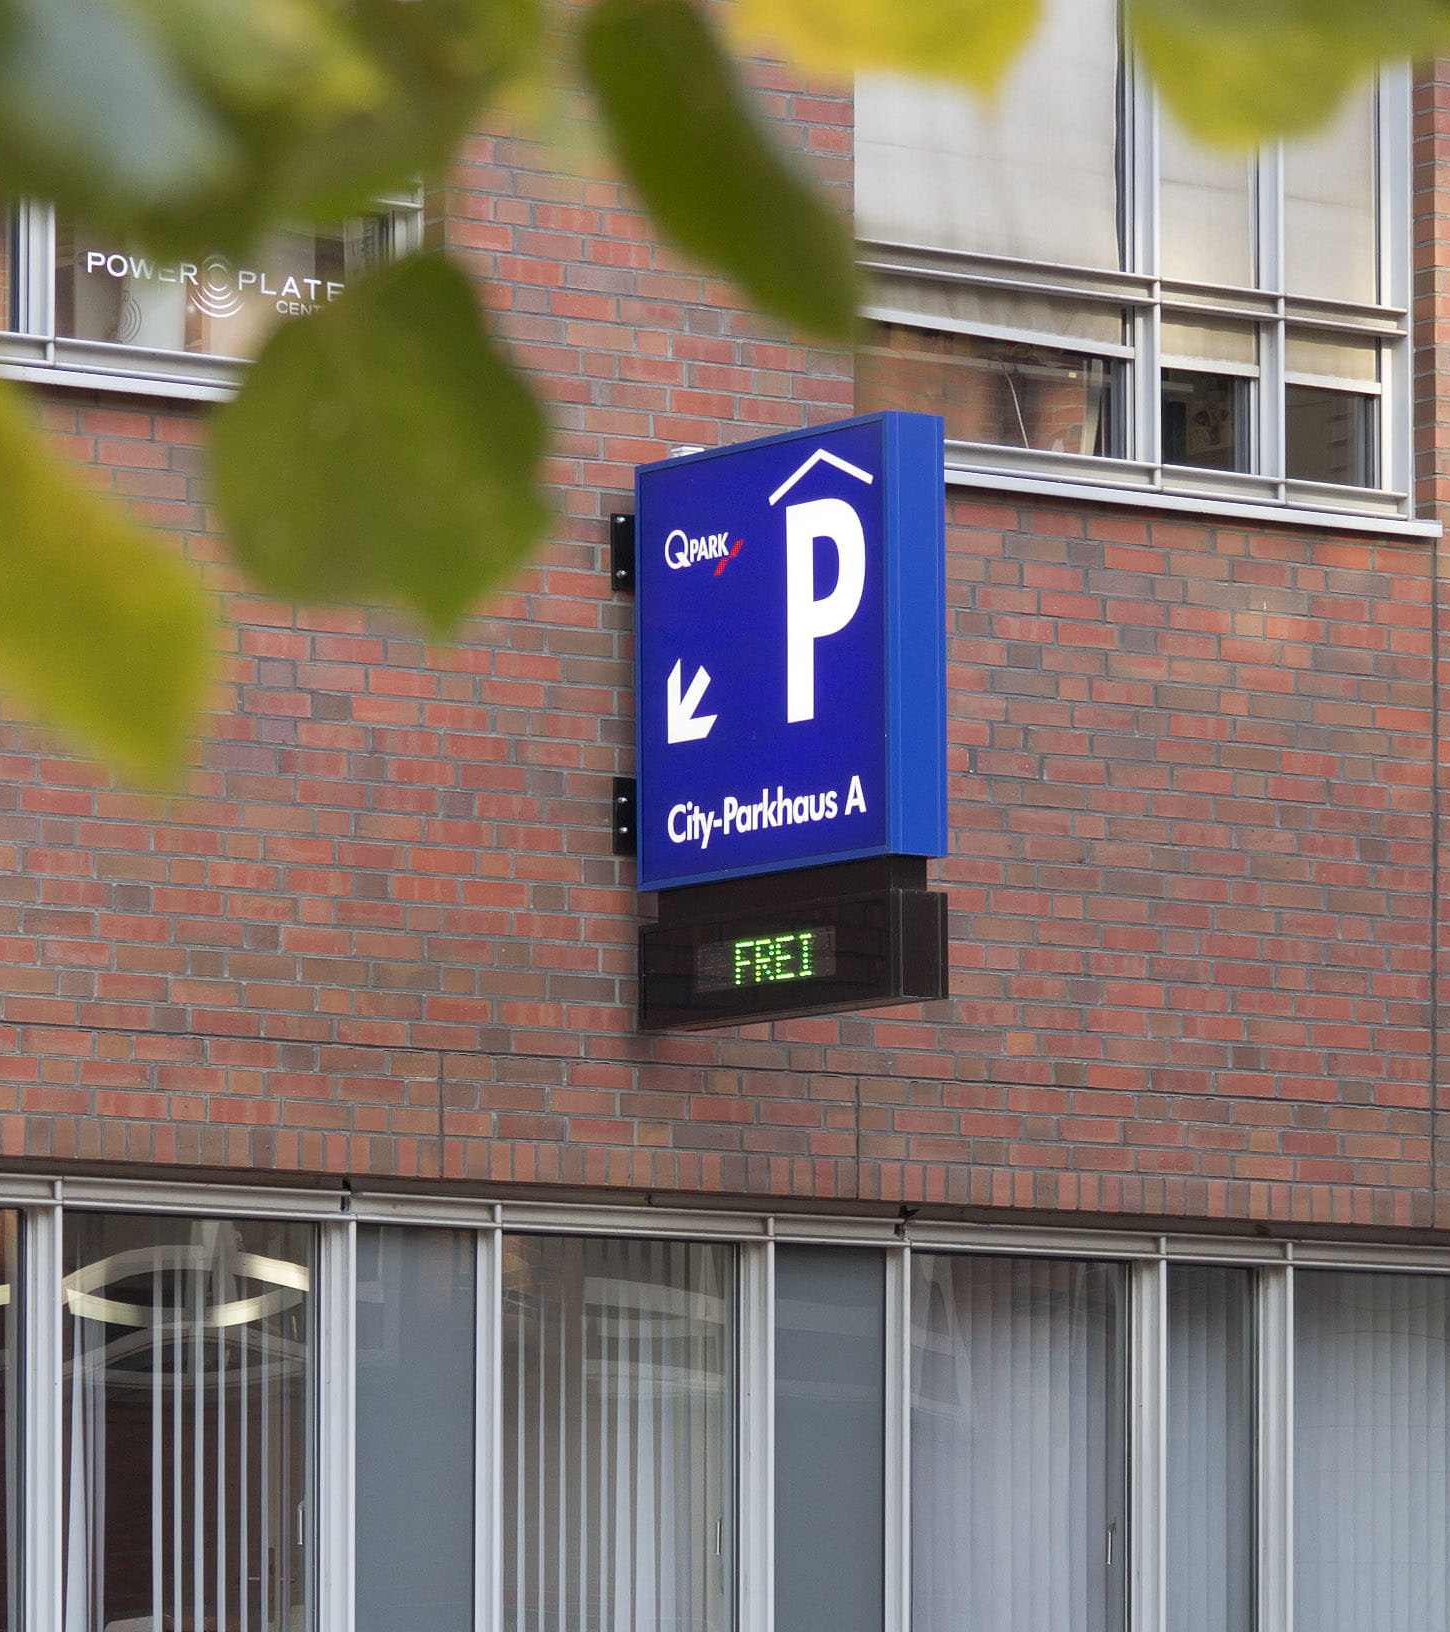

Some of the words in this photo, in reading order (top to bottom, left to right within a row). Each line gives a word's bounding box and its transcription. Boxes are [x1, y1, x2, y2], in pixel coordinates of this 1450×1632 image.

[86, 251, 198, 286] POWER
[238, 269, 345, 303] PLATE
[785, 498, 866, 724] P
[667, 784, 838, 849] City-Parkhaus
[844, 775, 867, 814] A
[734, 932, 815, 985] FREI
